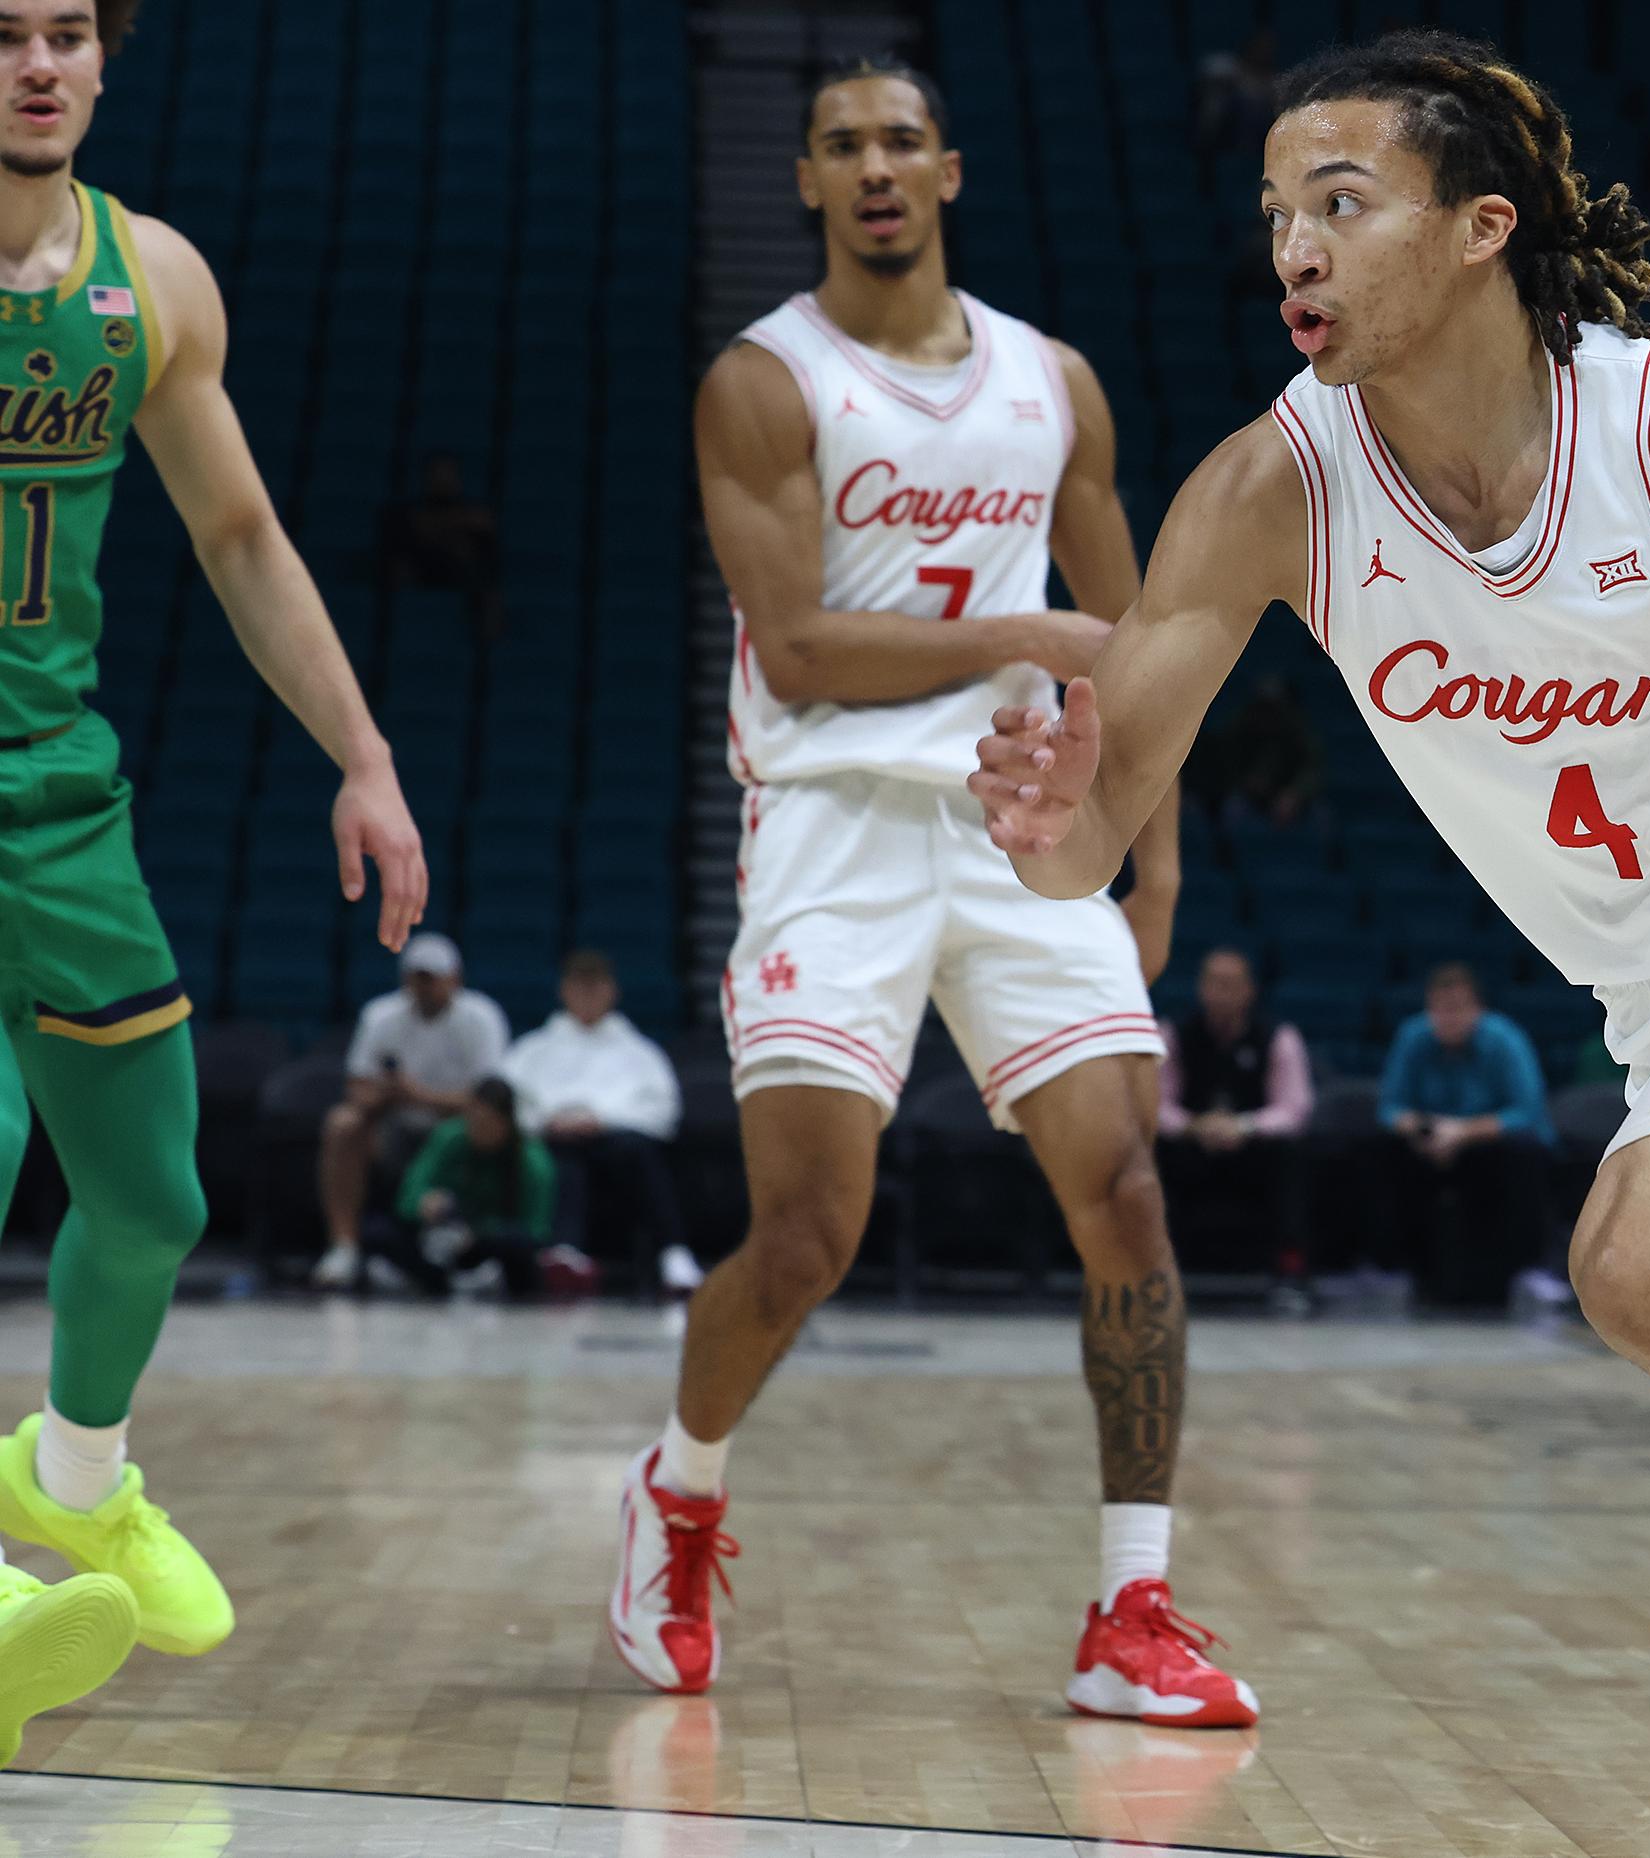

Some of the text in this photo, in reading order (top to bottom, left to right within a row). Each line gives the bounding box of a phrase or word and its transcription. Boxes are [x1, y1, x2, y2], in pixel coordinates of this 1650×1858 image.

[836, 459, 1046, 545] Cougars
[917, 566, 974, 620] 7
[1546, 764, 1643, 880] 4
